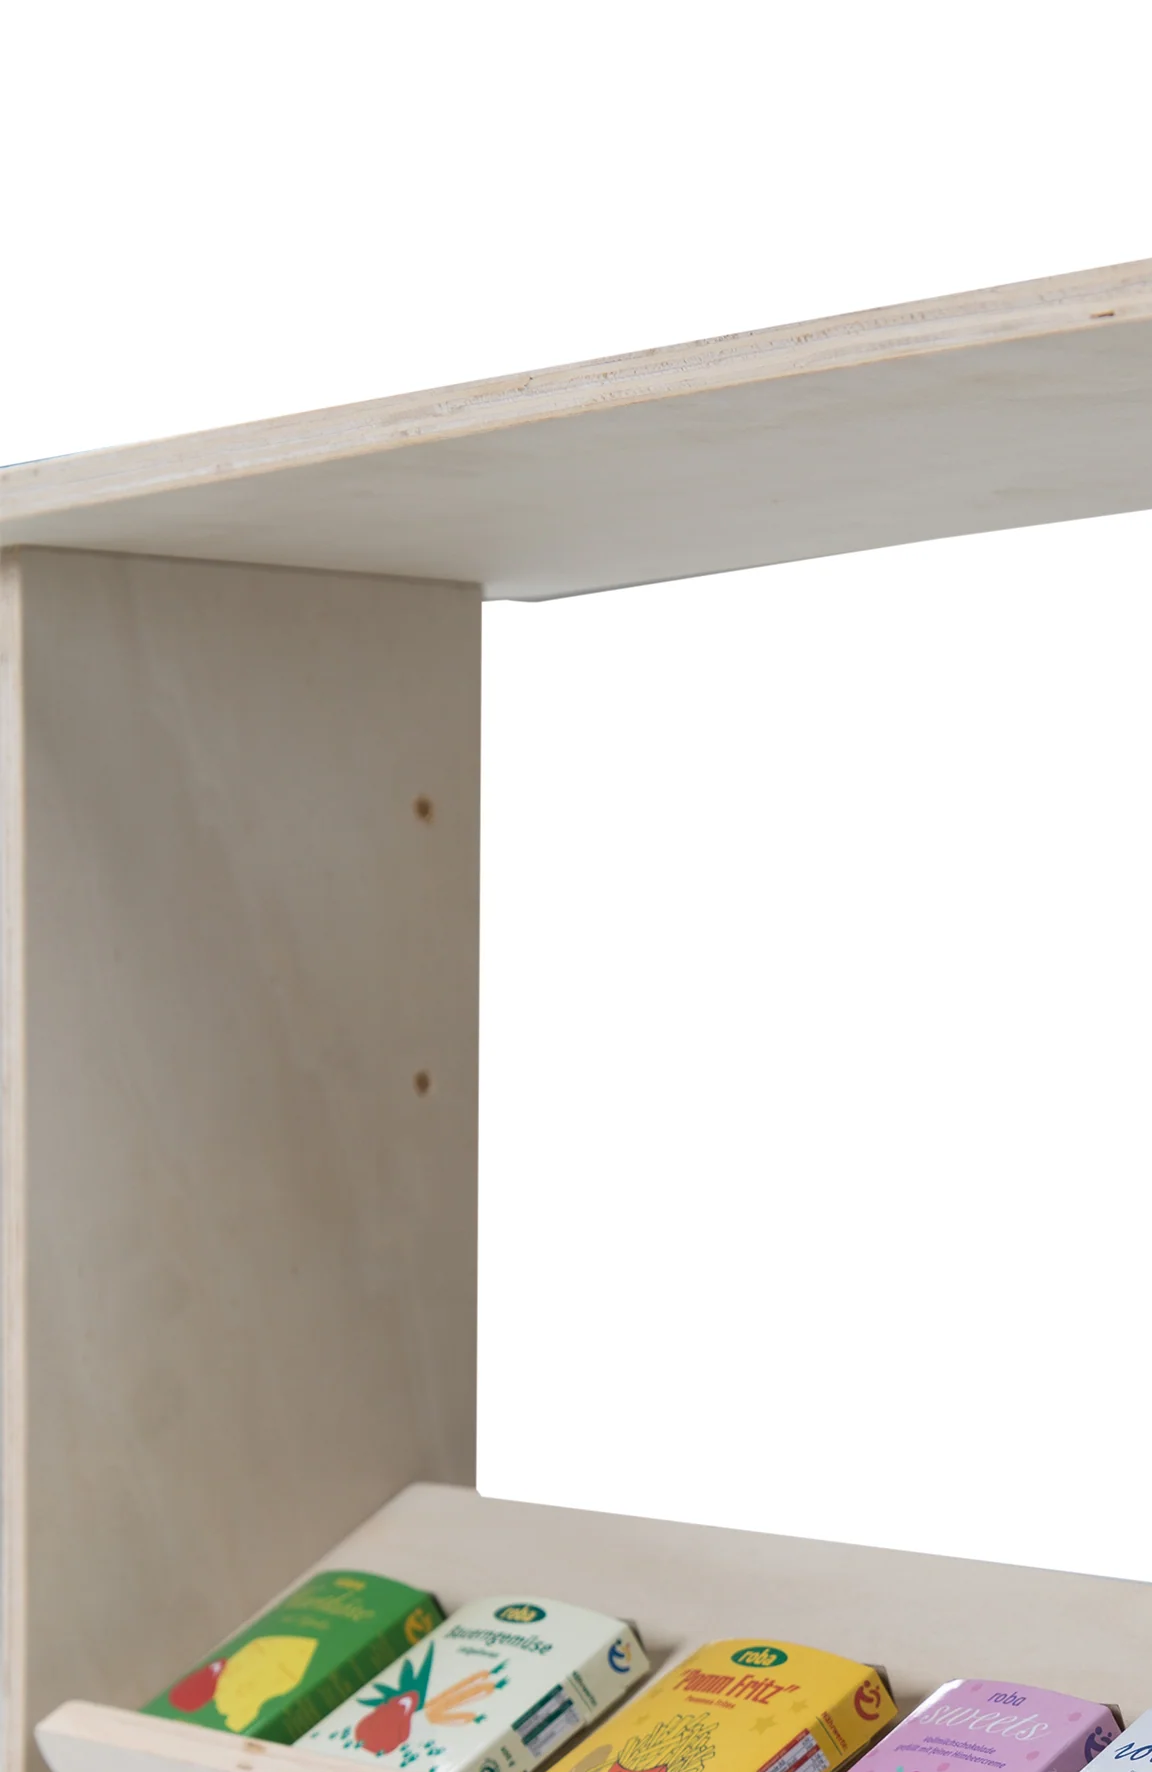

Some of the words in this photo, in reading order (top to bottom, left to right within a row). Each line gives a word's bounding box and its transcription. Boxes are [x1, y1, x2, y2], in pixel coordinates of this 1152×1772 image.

[738, 1648, 778, 1666] roba
[987, 1691, 1027, 1707] roba
[920, 1704, 1051, 1741] sweets
[920, 1745, 930, 1753] mit
[930, 1747, 952, 1758] feiner
